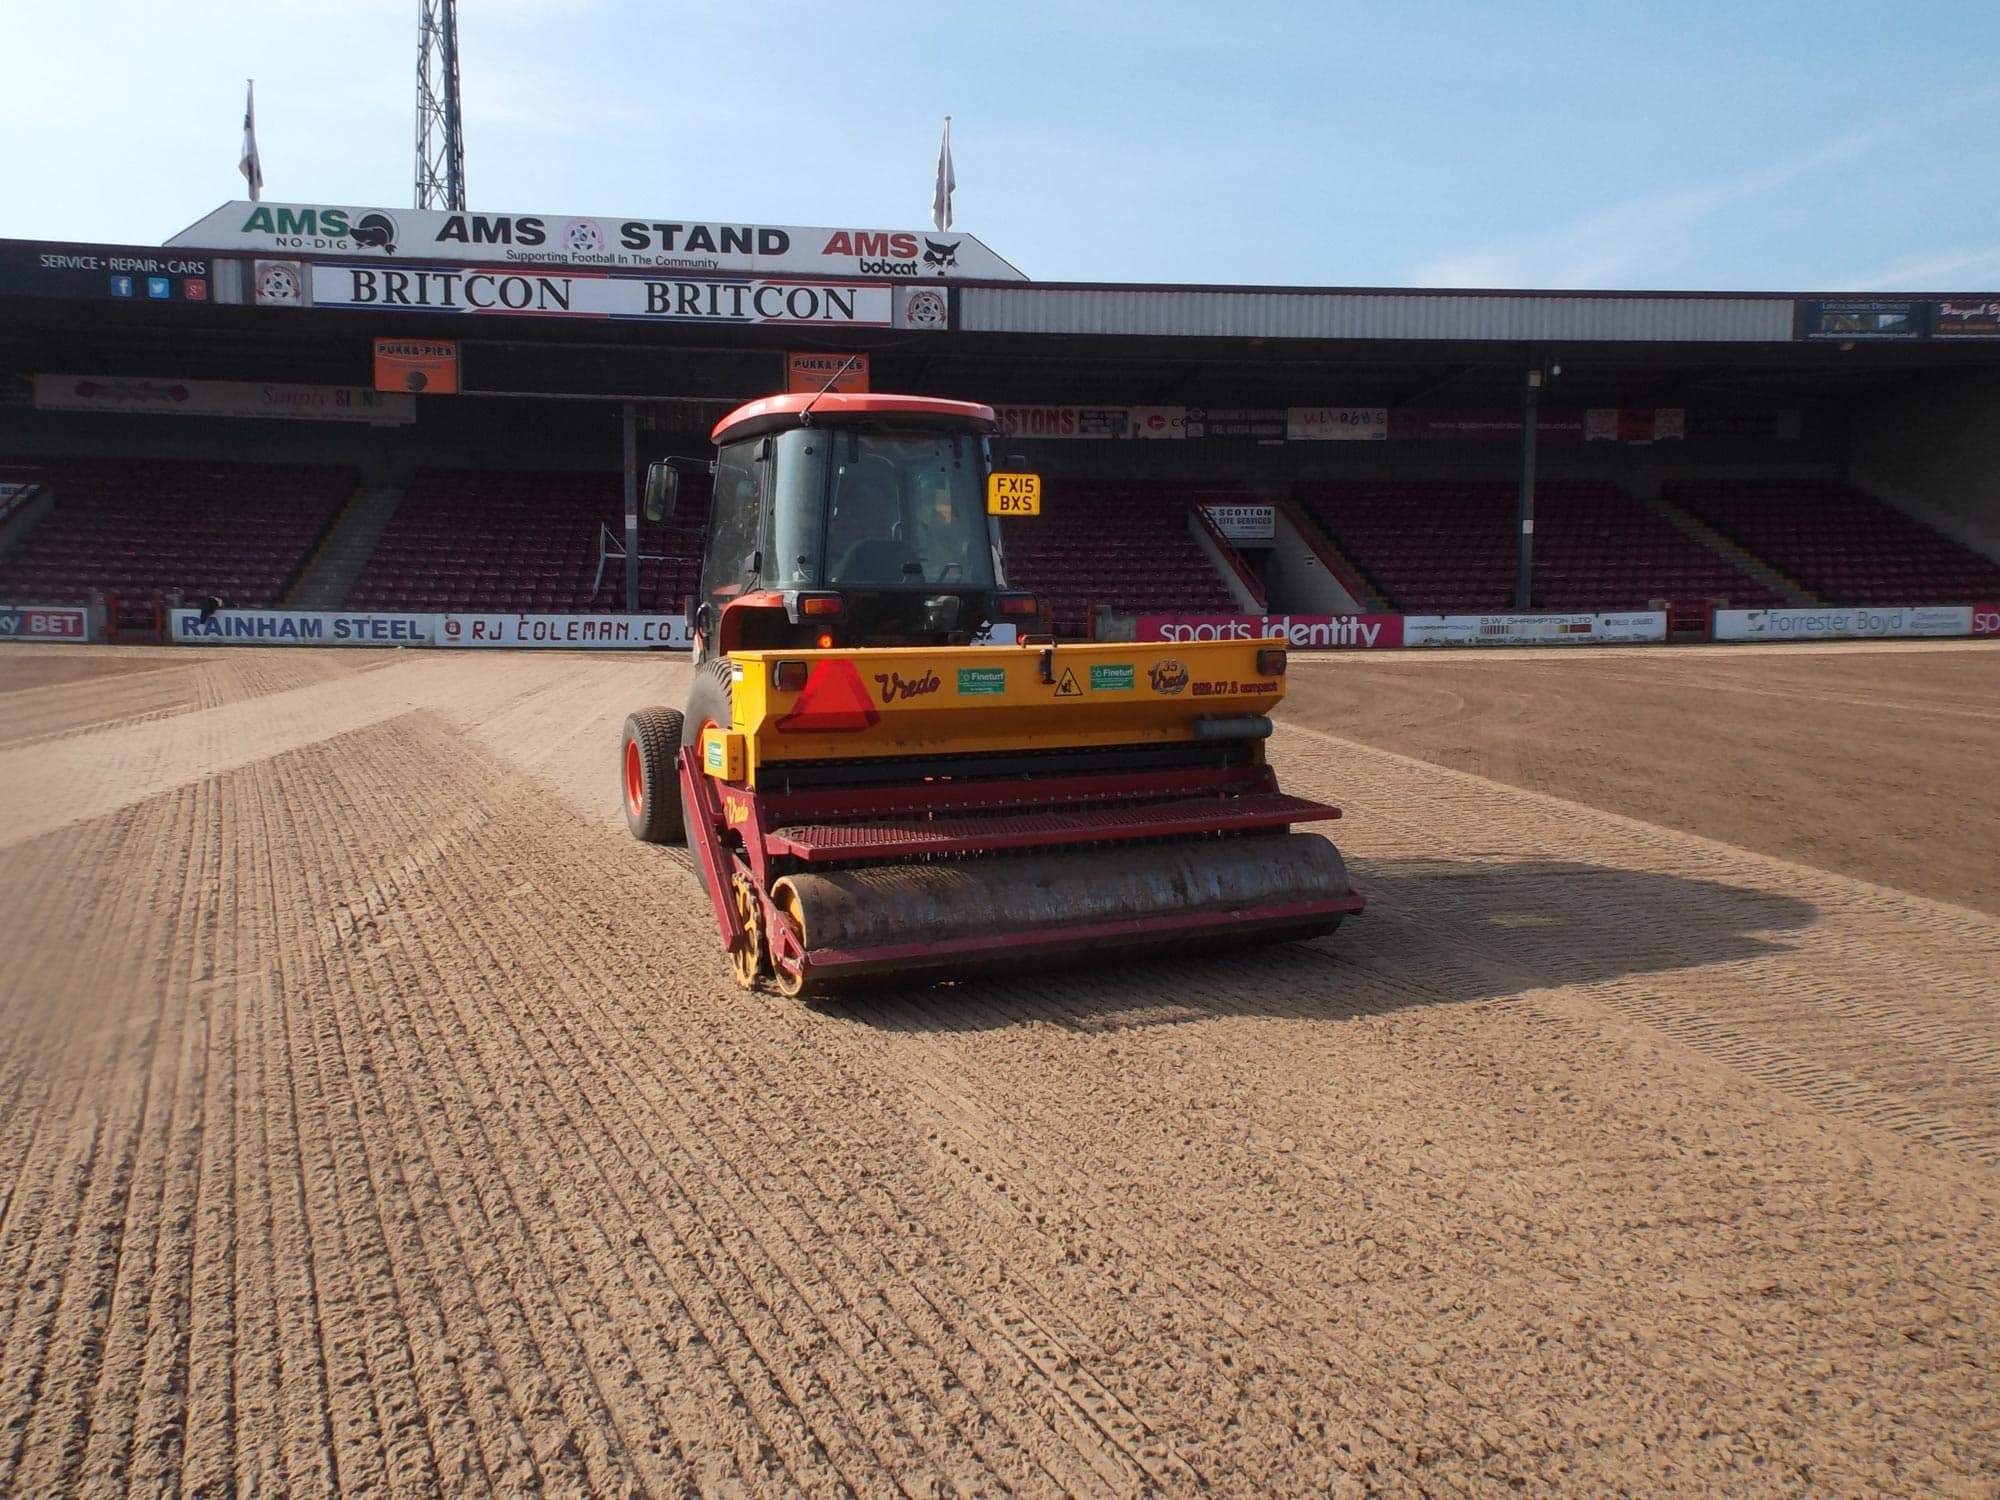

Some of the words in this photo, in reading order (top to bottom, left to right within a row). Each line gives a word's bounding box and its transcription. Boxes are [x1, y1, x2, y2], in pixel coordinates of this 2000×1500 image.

[241, 207, 350, 237] AMS
[276, 238, 348, 250] NO-DIG
[435, 215, 546, 246] AMS
[620, 222, 790, 255] STAND
[822, 231, 918, 259] AMS
[41, 254, 99, 270] SERVICE
[110, 257, 159, 272] REPAIR
[168, 260, 206, 274] CARS
[506, 249, 568, 264] Supporting
[572, 252, 615, 263] Football
[618, 255, 628, 264] In
[631, 255, 652, 265] The
[655, 255, 719, 269] Community
[860, 258, 918, 276] bobcat
[350, 270, 572, 310] BRITCON
[645, 282, 857, 320] BRITCON
[997, 478, 1035, 493] FX15
[1000, 496, 1033, 511] BXS
[1219, 508, 1272, 516] SCOTTON
[31, 615, 79, 633] BET
[182, 616, 323, 639] RAINHAM
[334, 618, 426, 640] STEEL
[1769, 612, 1850, 632] Forrester
[1857, 608, 1904, 633] Boyd
[472, 621, 503, 641] RJ
[1160, 619, 1252, 643] sports
[1262, 615, 1382, 648] identity
[971, 672, 1004, 681] Fineturf
[1103, 668, 1133, 677] Fineturf
[875, 670, 941, 703] Vredo
